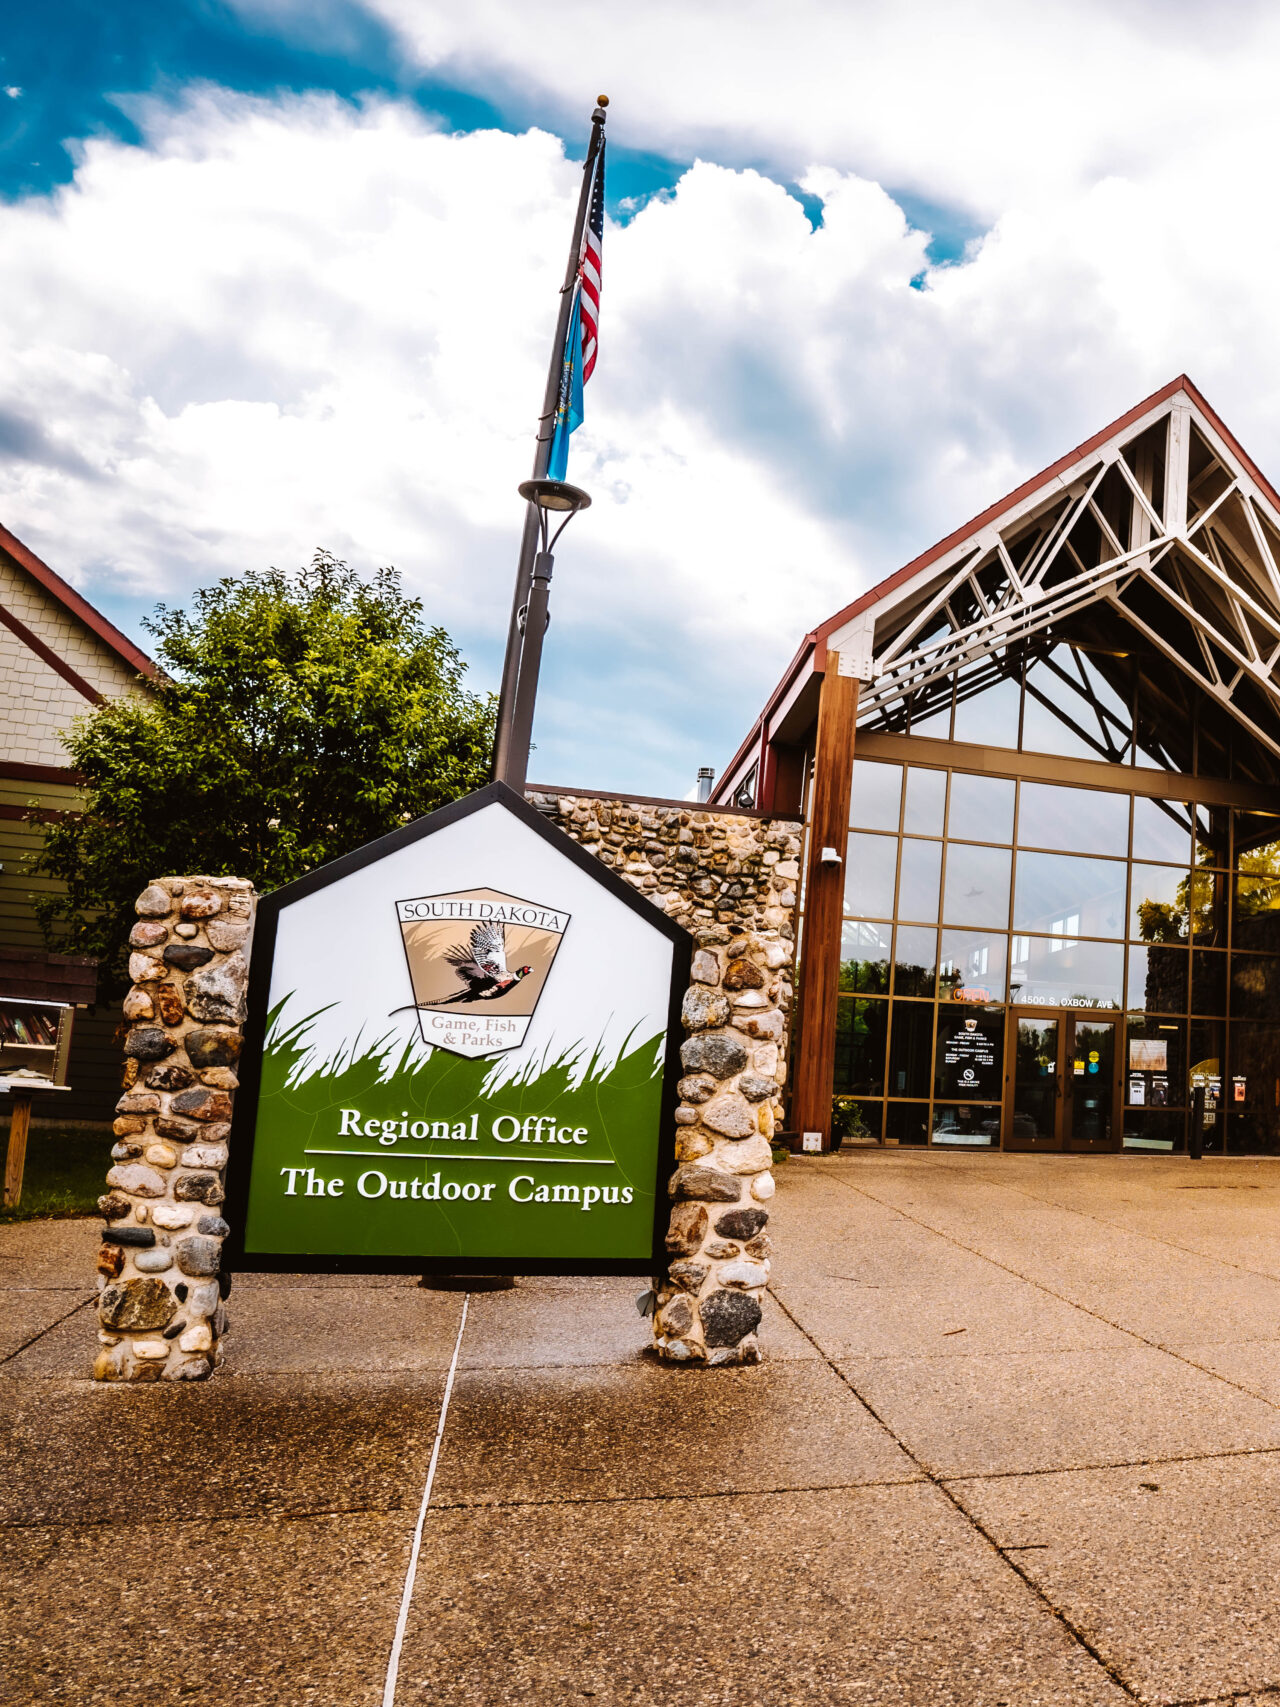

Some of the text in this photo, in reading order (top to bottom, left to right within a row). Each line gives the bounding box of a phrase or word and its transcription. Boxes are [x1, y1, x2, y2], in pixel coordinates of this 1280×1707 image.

[404, 902, 560, 930] SOUTH DAKOTA
[1021, 995, 1113, 1009] 4500 S. OXBOW AVE
[431, 1015, 517, 1033] Game, Fish
[442, 1032, 503, 1047] & Parks
[337, 1108, 589, 1146] Regional Office
[280, 1167, 635, 1211] The Outdoor Campus
